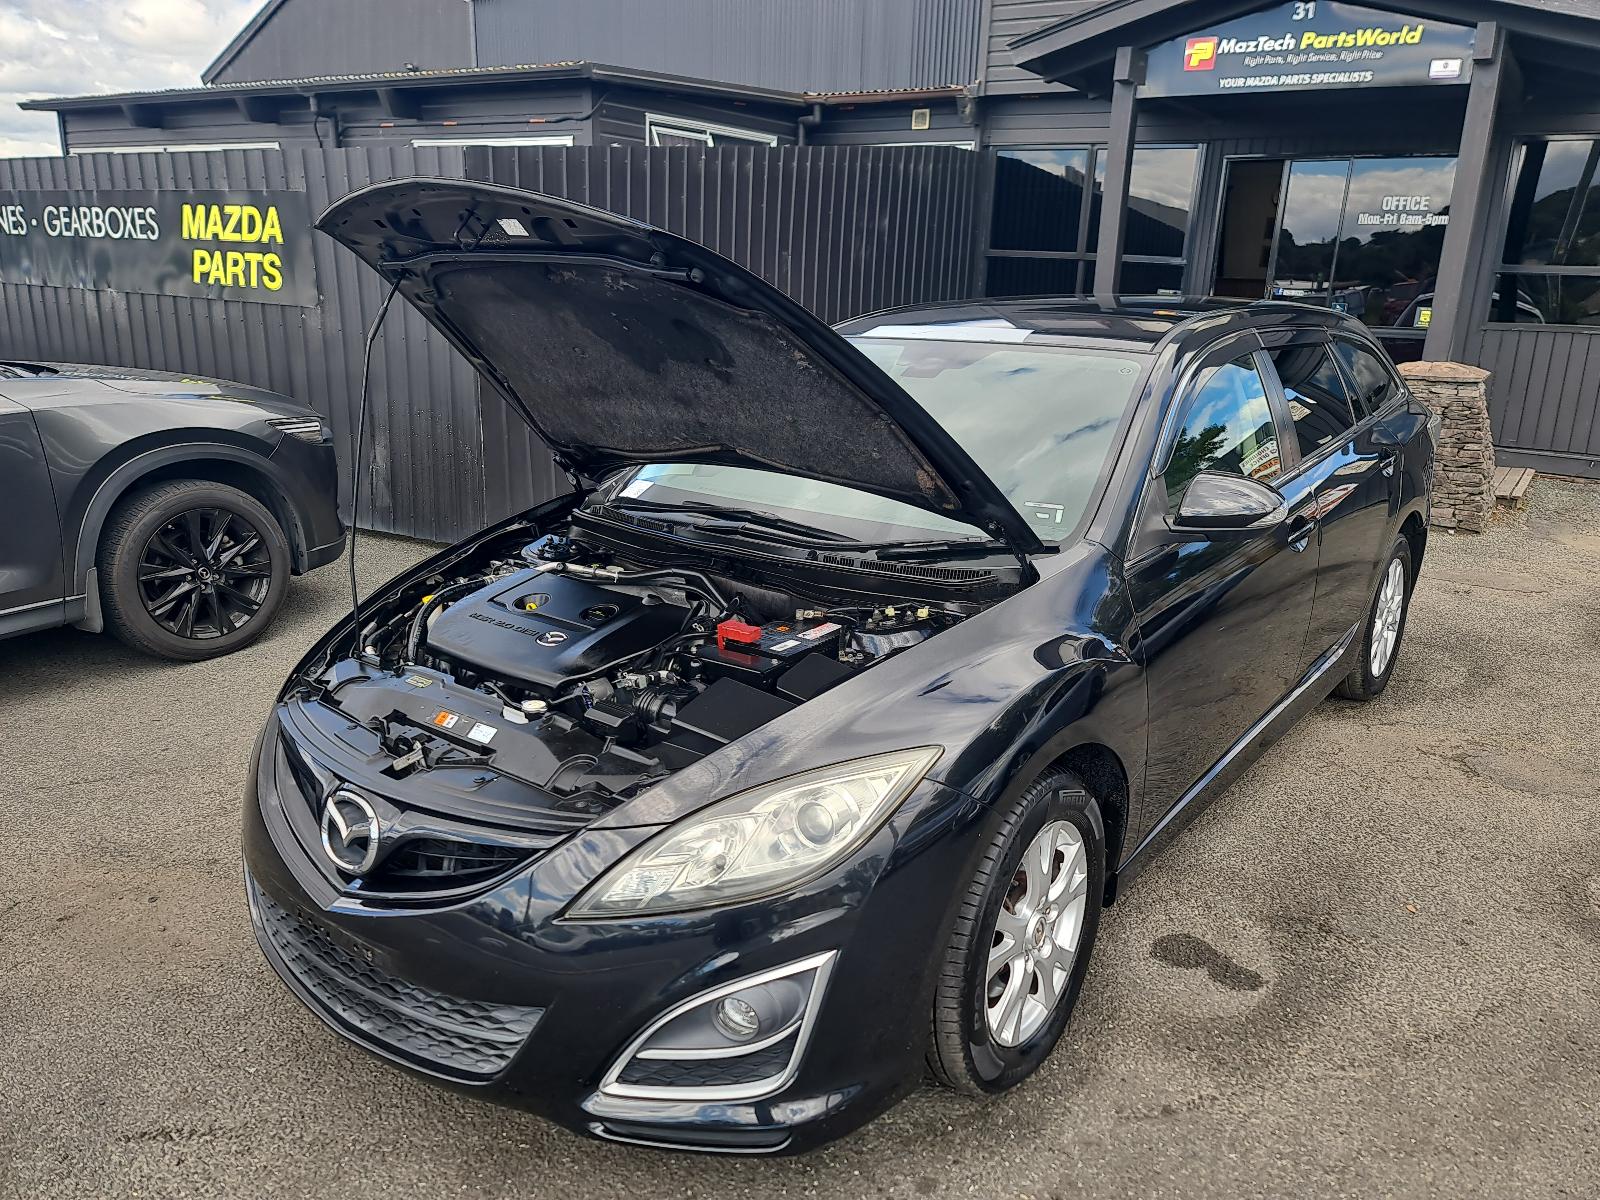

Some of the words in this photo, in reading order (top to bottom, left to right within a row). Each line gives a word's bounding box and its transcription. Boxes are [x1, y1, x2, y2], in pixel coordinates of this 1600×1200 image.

[1292, 1, 1316, 20] 31
[1217, 34, 1296, 54] MazTech
[1299, 24, 1424, 50] PartsWorld
[1219, 78, 1246, 88] YOUR
[1245, 76, 1279, 87] MAZDA
[1279, 74, 1311, 86] PARTS
[1311, 71, 1374, 83] SPECIALISTS
[1382, 196, 1430, 211] OFFICE
[43, 205, 160, 241] GEARBOXES
[181, 204, 284, 244] MAZDA
[1358, 213, 1399, 225] Mon-Fri
[1400, 213, 1450, 227] 8am-5pm
[192, 249, 283, 291] PARTS
